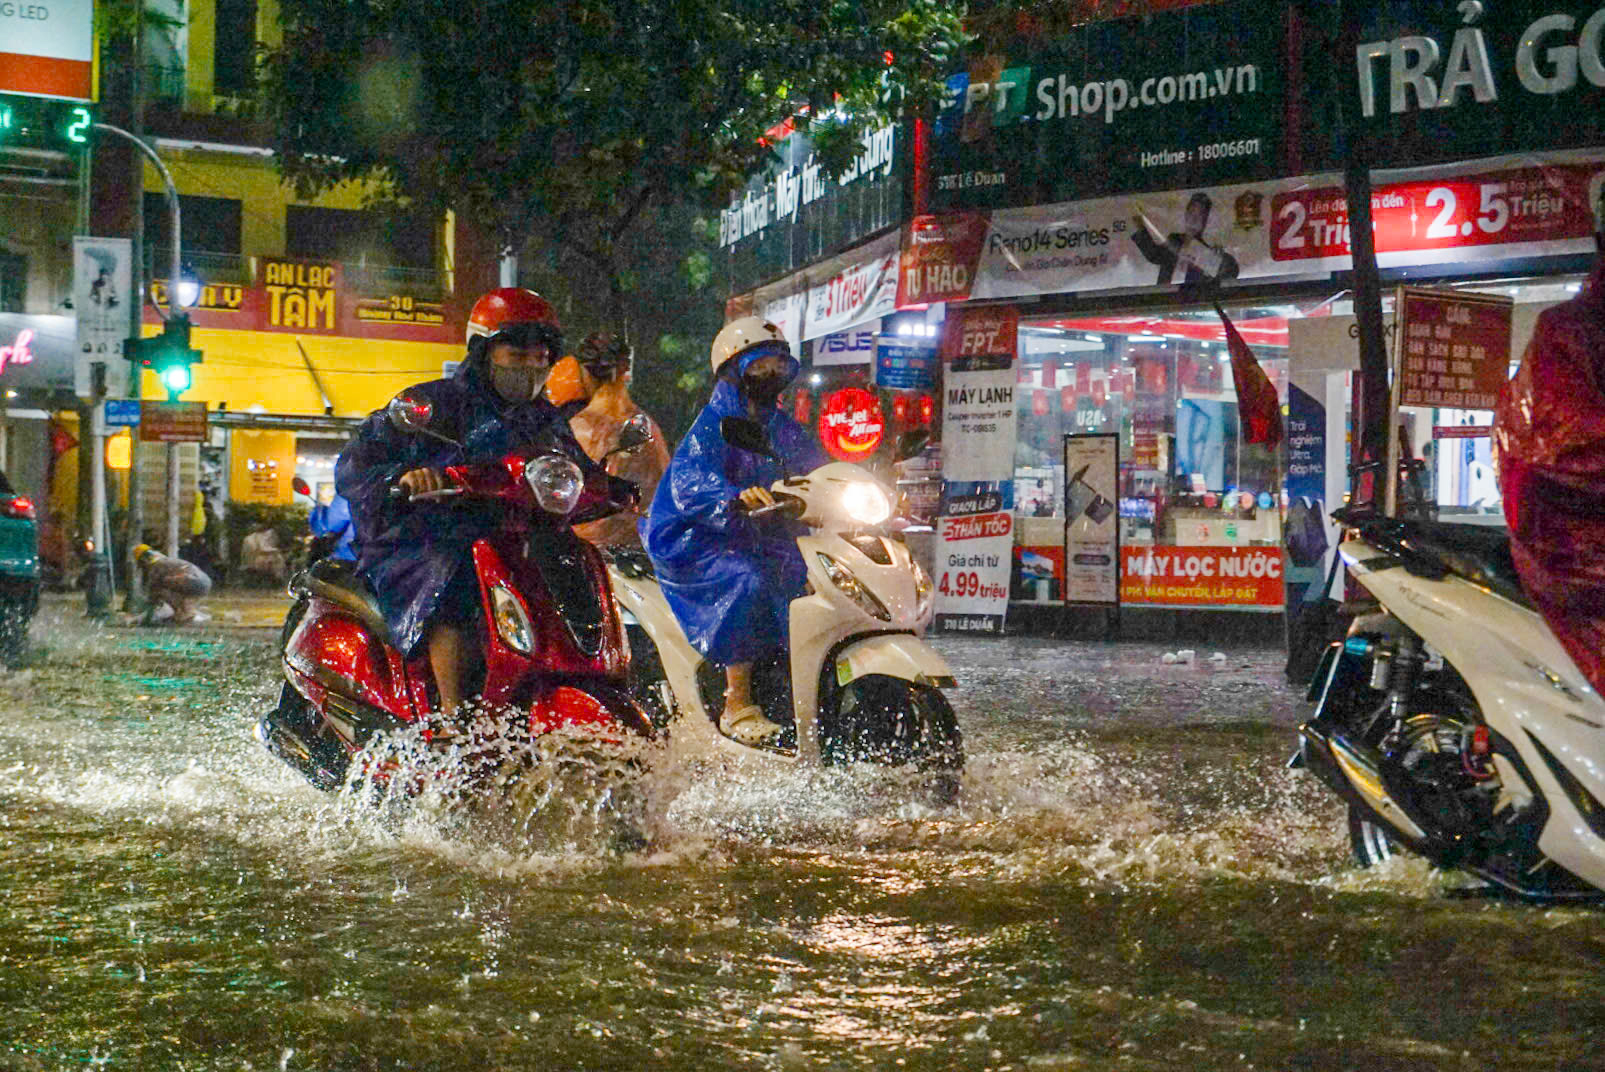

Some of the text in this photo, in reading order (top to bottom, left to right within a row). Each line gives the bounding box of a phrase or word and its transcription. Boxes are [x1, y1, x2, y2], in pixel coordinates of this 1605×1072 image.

[19, 4, 49, 20] LED
[1356, 0, 1498, 117] TRẢ
[1036, 63, 1257, 124] Shop.com.vn
[67, 108, 91, 142] 2
[1197, 138, 1260, 162] 18006601
[1278, 200, 1306, 249] 2
[1424, 183, 1509, 239] 2.5
[1054, 227, 1111, 250] Series
[266, 262, 295, 285] AN
[265, 286, 337, 330] TÂM
[819, 331, 873, 353] ASUS
[948, 384, 1013, 408] MÁY LẠNH
[984, 514, 1008, 535] TỐC
[948, 553, 966, 568] Giá
[1127, 549, 1281, 582] MÁY LỌC NƯỚC
[938, 571, 1007, 602] 4.99 triệu
